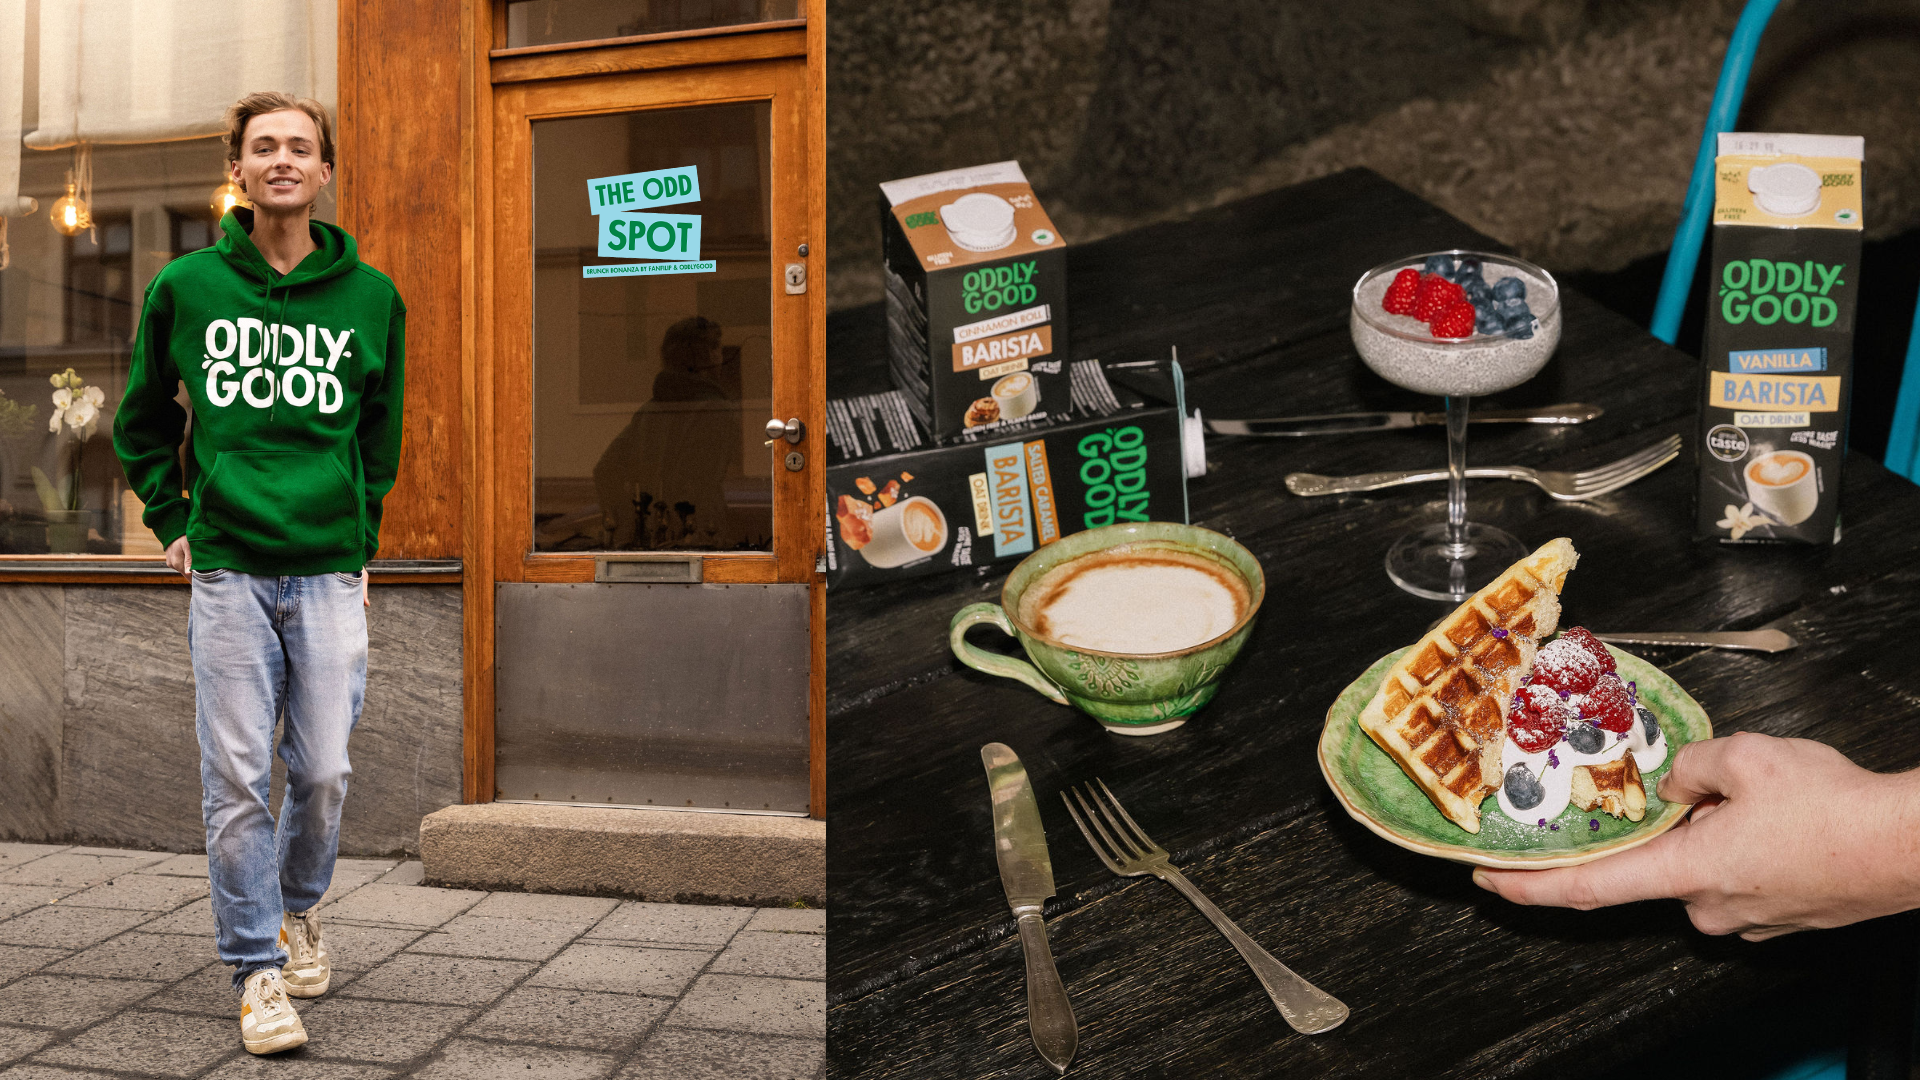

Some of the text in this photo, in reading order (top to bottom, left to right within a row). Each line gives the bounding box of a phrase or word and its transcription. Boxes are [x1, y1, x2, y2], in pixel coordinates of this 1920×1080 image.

[594, 174, 692, 206] THE ODD
[607, 219, 693, 252] SPOT
[586, 267, 610, 275] BRUNCH
[610, 266, 640, 274] BONANZA
[679, 263, 714, 271] ODDLYGOOD
[962, 260, 1037, 293] ODDLY
[1722, 258, 1844, 296] ODDLY
[963, 284, 1037, 314] GOOD
[1721, 290, 1838, 328] GOOD
[958, 311, 1044, 338] CINNAMON ROLL
[205, 317, 351, 372] ODDLY
[961, 332, 1044, 366] BARISTA
[1738, 352, 1813, 370] VANILLA
[205, 360, 344, 414] GOOD
[982, 367, 999, 377] OAT
[1723, 379, 1827, 406] BARISTA
[1740, 414, 1805, 425] OAT DRINK
[1711, 436, 1746, 451] taste
[973, 478, 986, 499] OAT
[1078, 432, 1117, 530] GOOD
[1109, 426, 1151, 523] ODDLY
[993, 455, 1026, 546] BARISTA
[1027, 444, 1056, 541] SALTED CARAMEL
